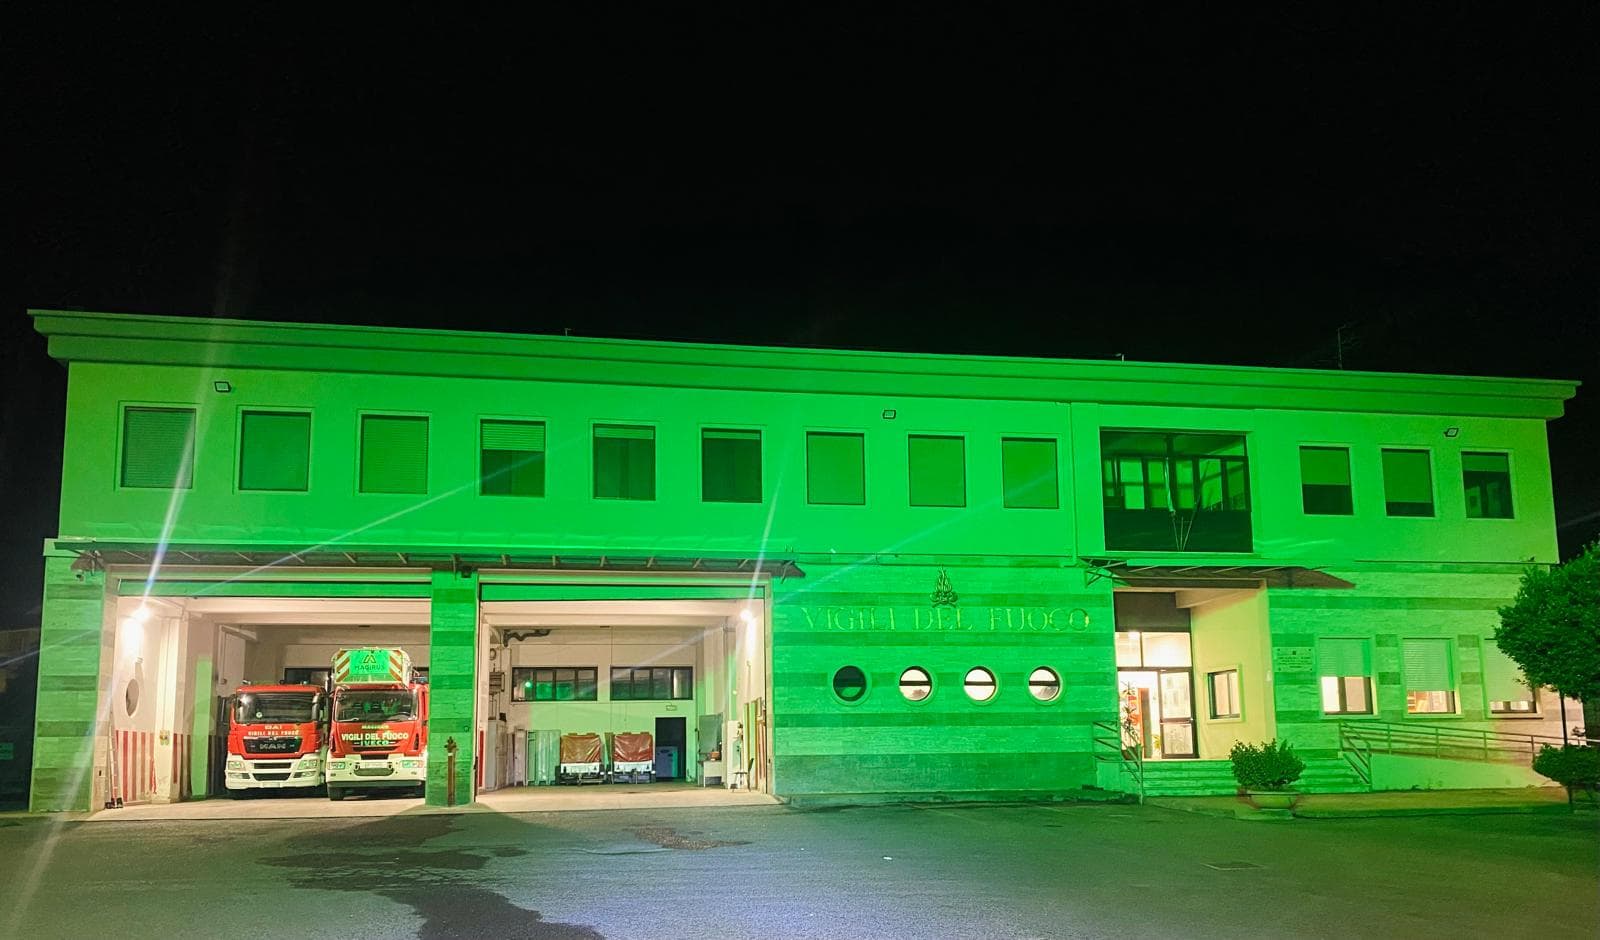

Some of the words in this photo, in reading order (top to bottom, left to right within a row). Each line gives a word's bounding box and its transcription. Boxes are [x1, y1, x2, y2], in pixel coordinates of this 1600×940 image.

[800, 607, 897, 631] VIGILI
[914, 607, 973, 631] DEL
[989, 607, 1091, 631] FUOCO
[341, 733, 364, 741] VIGILI
[365, 733, 381, 741] DEL
[382, 732, 409, 740] FUOCO
